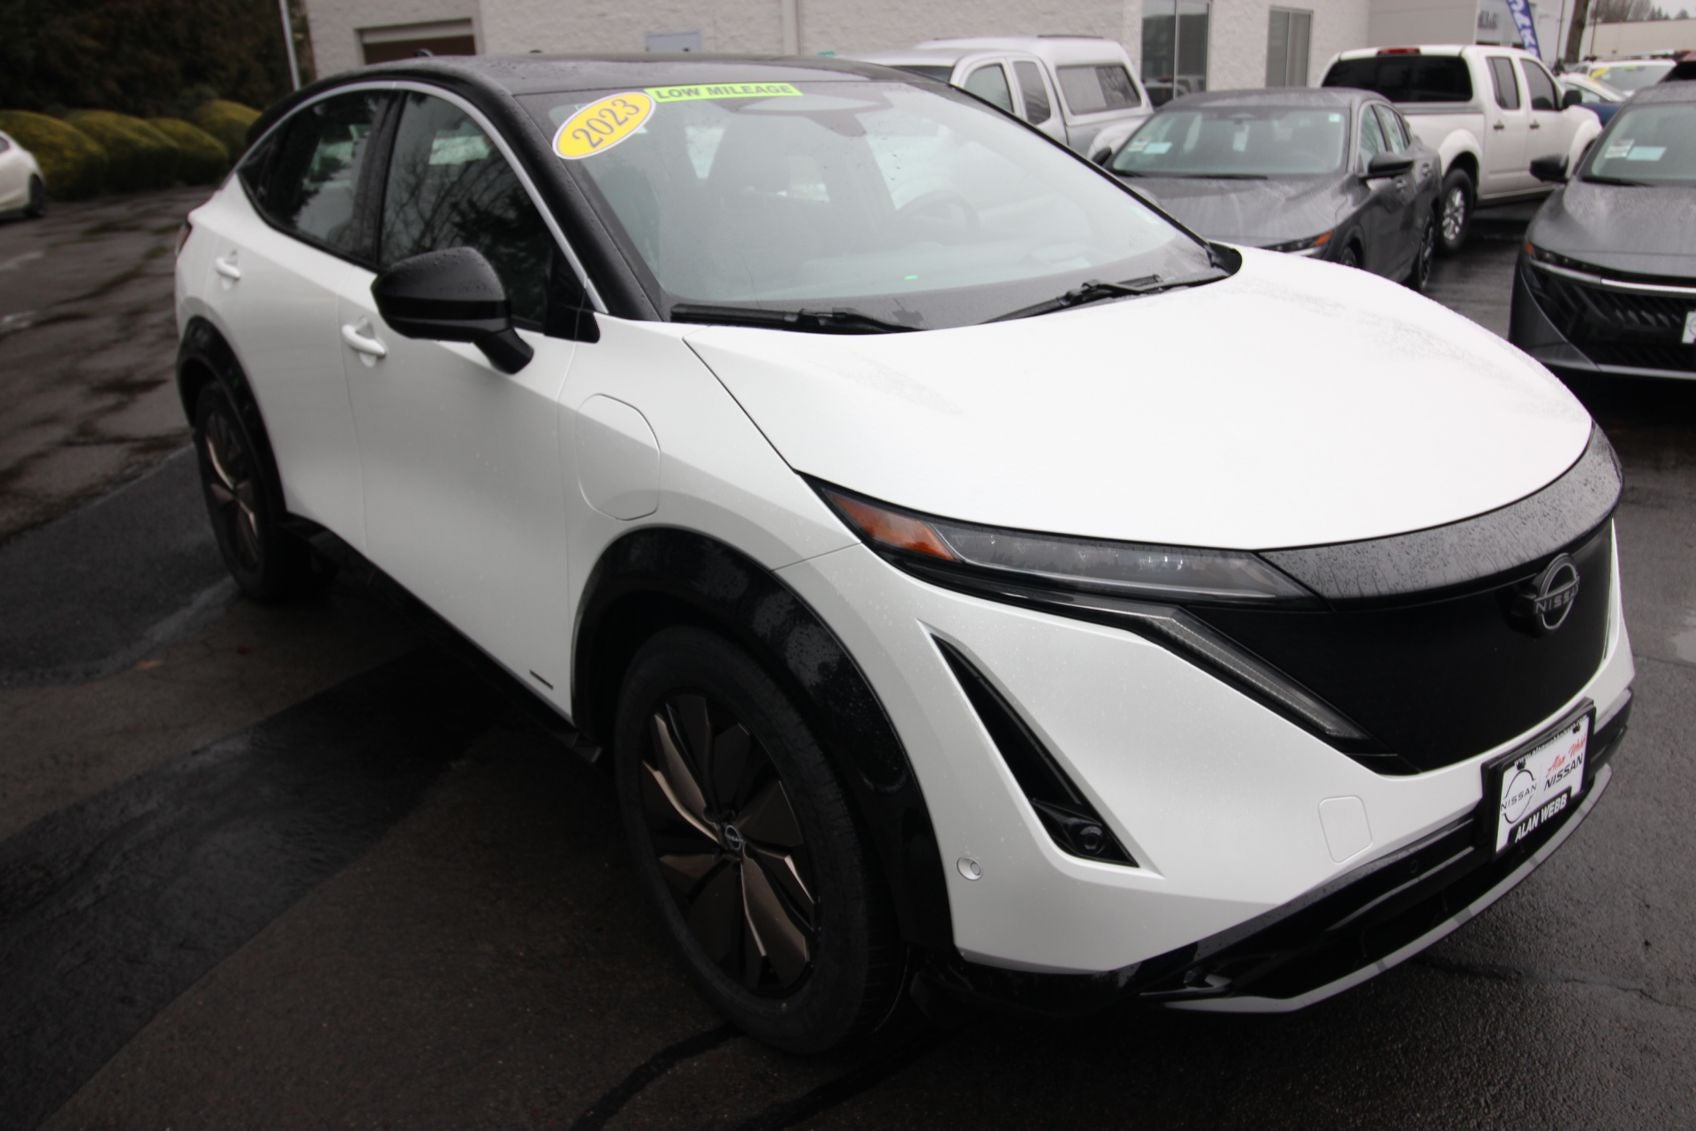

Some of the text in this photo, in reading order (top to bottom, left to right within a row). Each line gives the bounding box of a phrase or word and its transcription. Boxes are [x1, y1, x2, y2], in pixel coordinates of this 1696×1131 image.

[655, 83, 792, 100] LOW MILEAGE
[571, 97, 641, 149] 2023
[1544, 752, 1584, 791] NISSAN
[1501, 783, 1537, 812] NISSAN
[1514, 792, 1568, 844] ALAN WEBB
